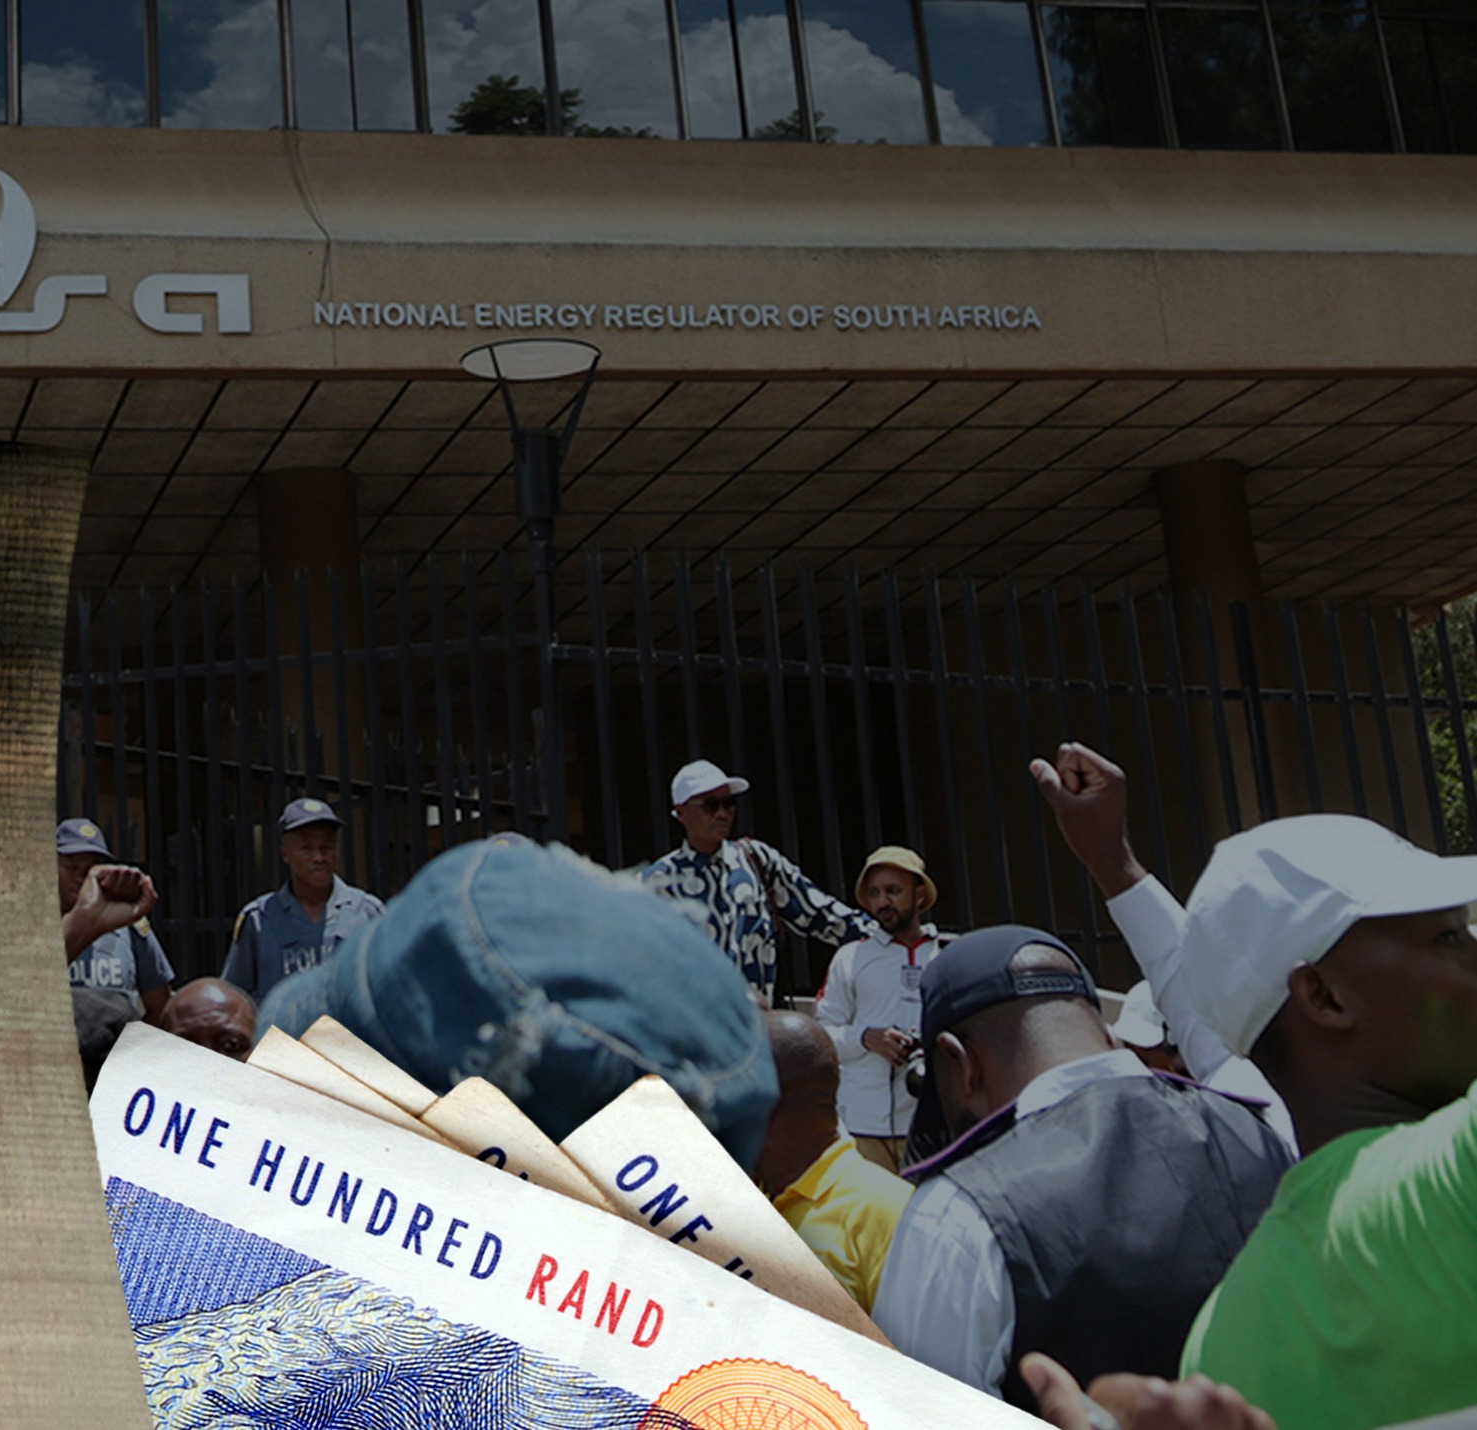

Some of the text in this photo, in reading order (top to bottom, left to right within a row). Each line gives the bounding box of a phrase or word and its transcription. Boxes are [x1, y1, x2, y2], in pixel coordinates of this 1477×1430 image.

[313, 301, 1043, 329] NATIONAL ENERGY REGULATOR OF SOUTH AFRICA
[67, 957, 124, 988] OLICE
[122, 1086, 666, 1350] ONE HUNDRED RAND
